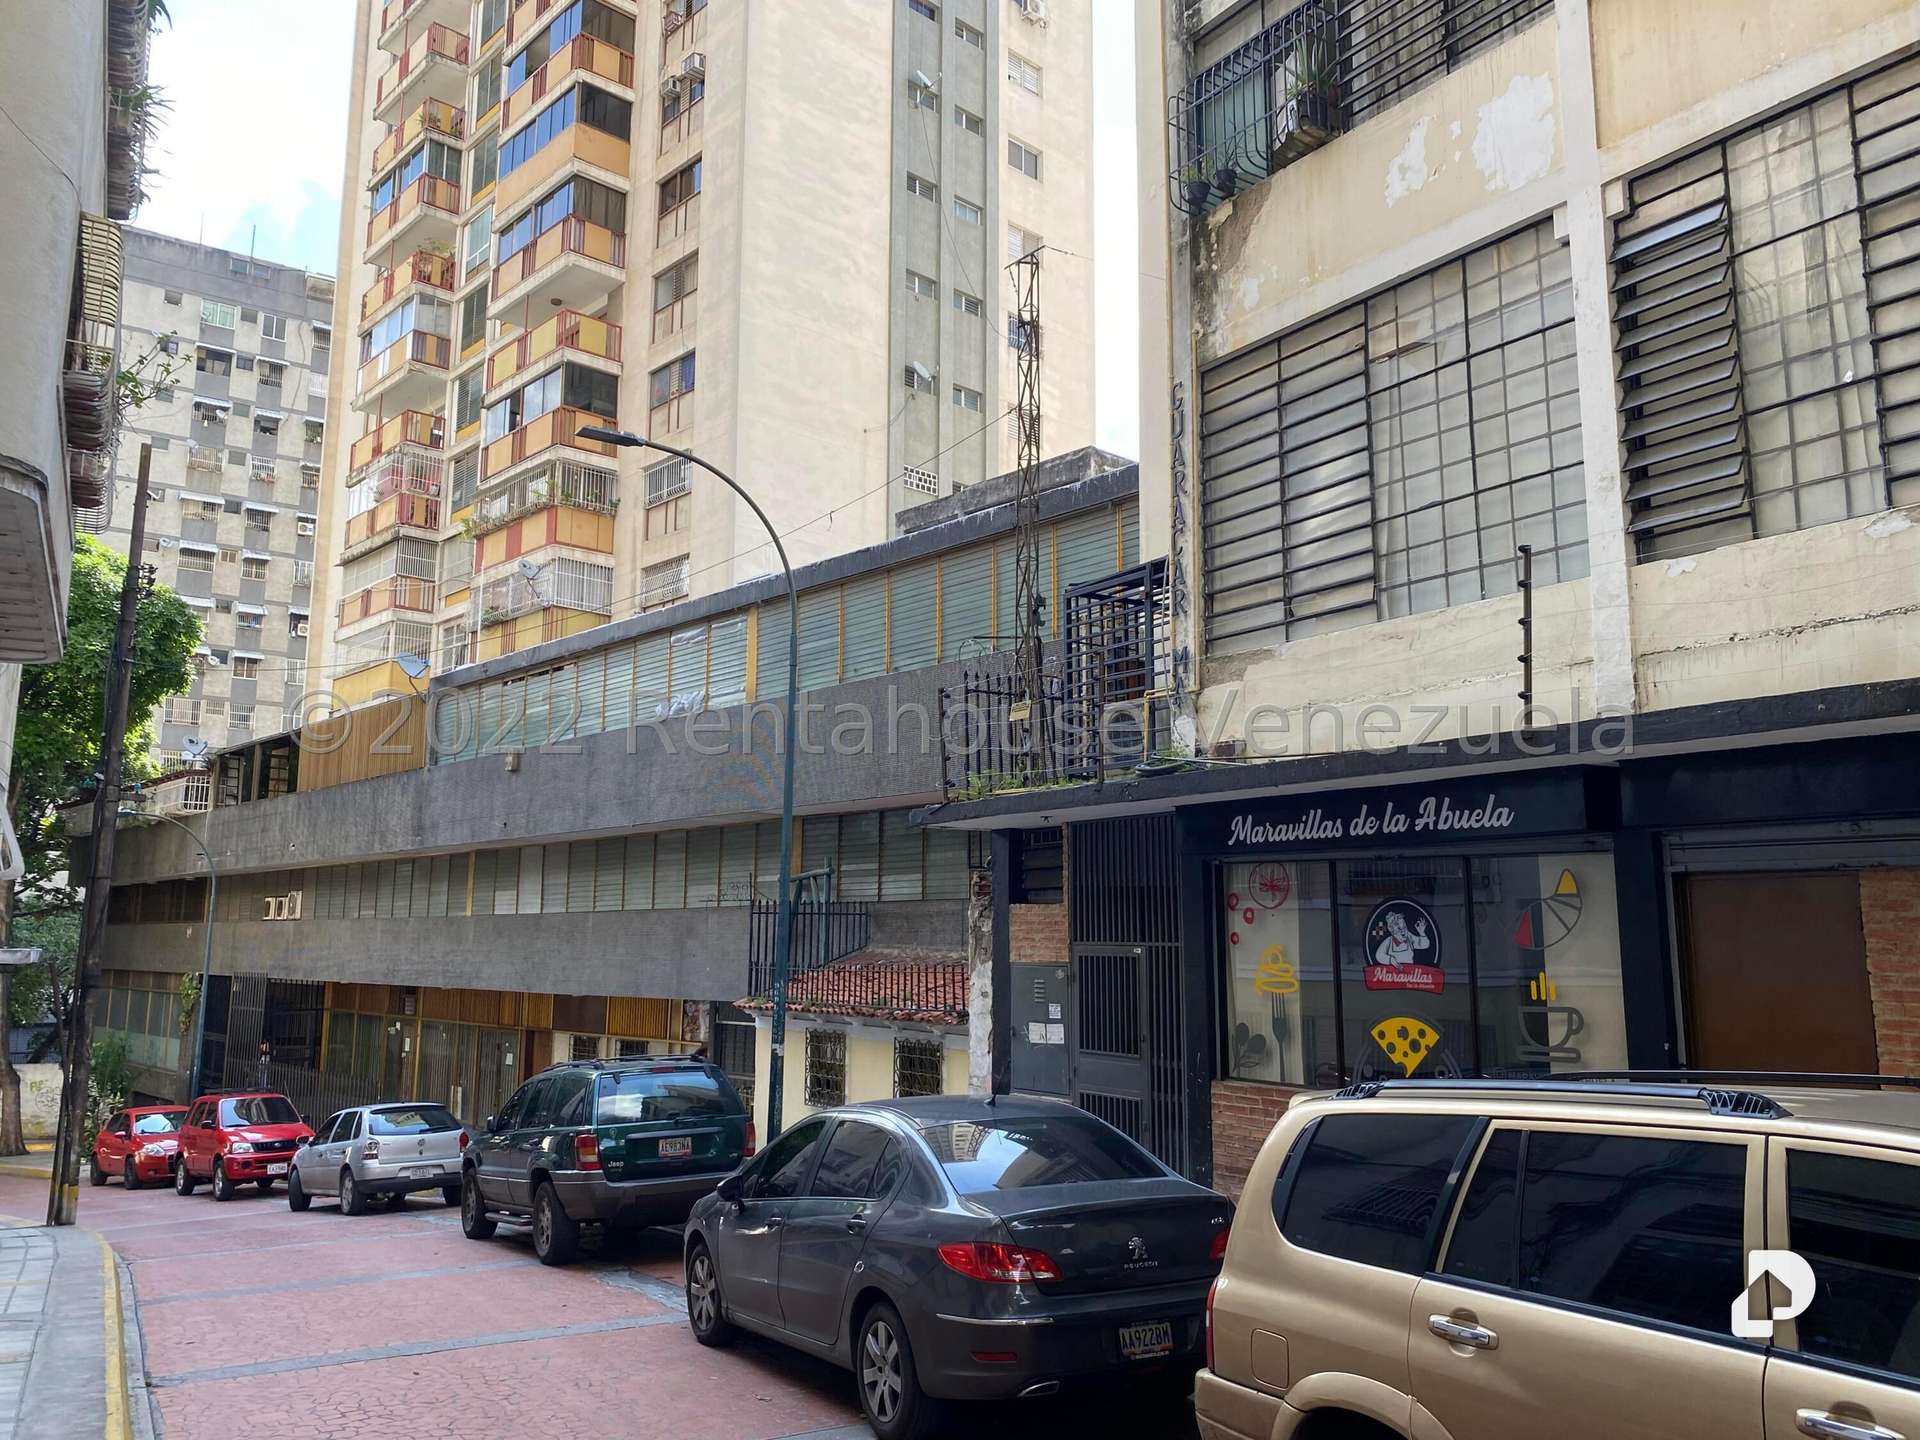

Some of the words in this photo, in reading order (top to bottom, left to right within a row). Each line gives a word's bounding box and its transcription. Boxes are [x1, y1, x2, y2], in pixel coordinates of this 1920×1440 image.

[1228, 809, 1343, 846] Maravillas
[1350, 804, 1379, 836] de
[1383, 802, 1410, 833] la
[1415, 794, 1514, 831] Abuela
[1372, 967, 1433, 983] Maravillas
[1124, 1261, 1158, 1269] PEUGEOT
